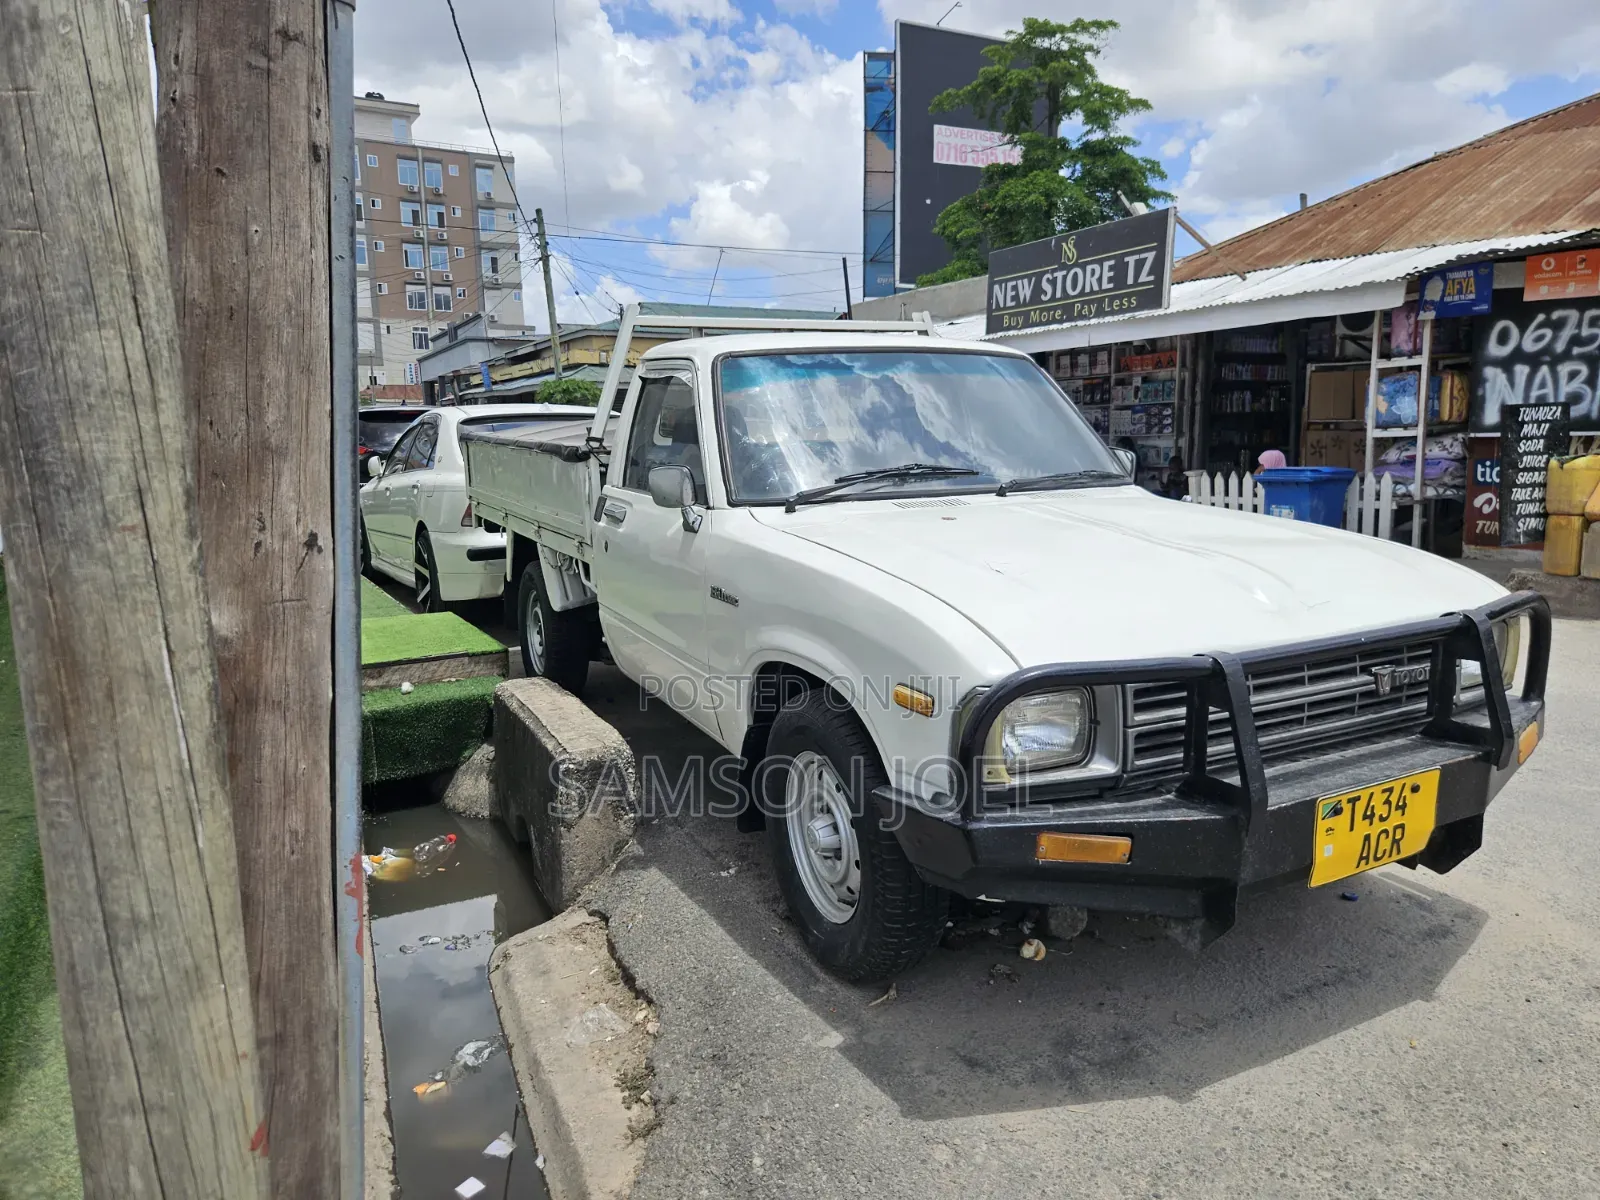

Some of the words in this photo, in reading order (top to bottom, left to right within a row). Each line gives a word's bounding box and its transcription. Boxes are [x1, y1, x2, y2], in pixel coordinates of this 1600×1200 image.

[936, 141, 968, 164] 0716
[992, 277, 1036, 310] NEW
[1040, 259, 1115, 301] STORE
[1123, 251, 1157, 285] TZ
[1534, 271, 1562, 279] vodacom
[1445, 276, 1476, 297] AFYA
[1003, 314, 1024, 328] Buy
[1074, 303, 1097, 317] Pay
[1105, 296, 1137, 311] Less
[1487, 308, 1600, 357] 0675
[1518, 405, 1562, 422] TUNAUZA
[1520, 423, 1550, 438] MAJI
[1517, 439, 1544, 453] SODA
[1518, 454, 1549, 469] JUICE
[1511, 487, 1532, 501] TAKE
[1516, 517, 1546, 533] SIMU
[1394, 666, 1431, 686] TOYOT
[1346, 782, 1408, 833] T434
[1355, 822, 1406, 869] ACR
